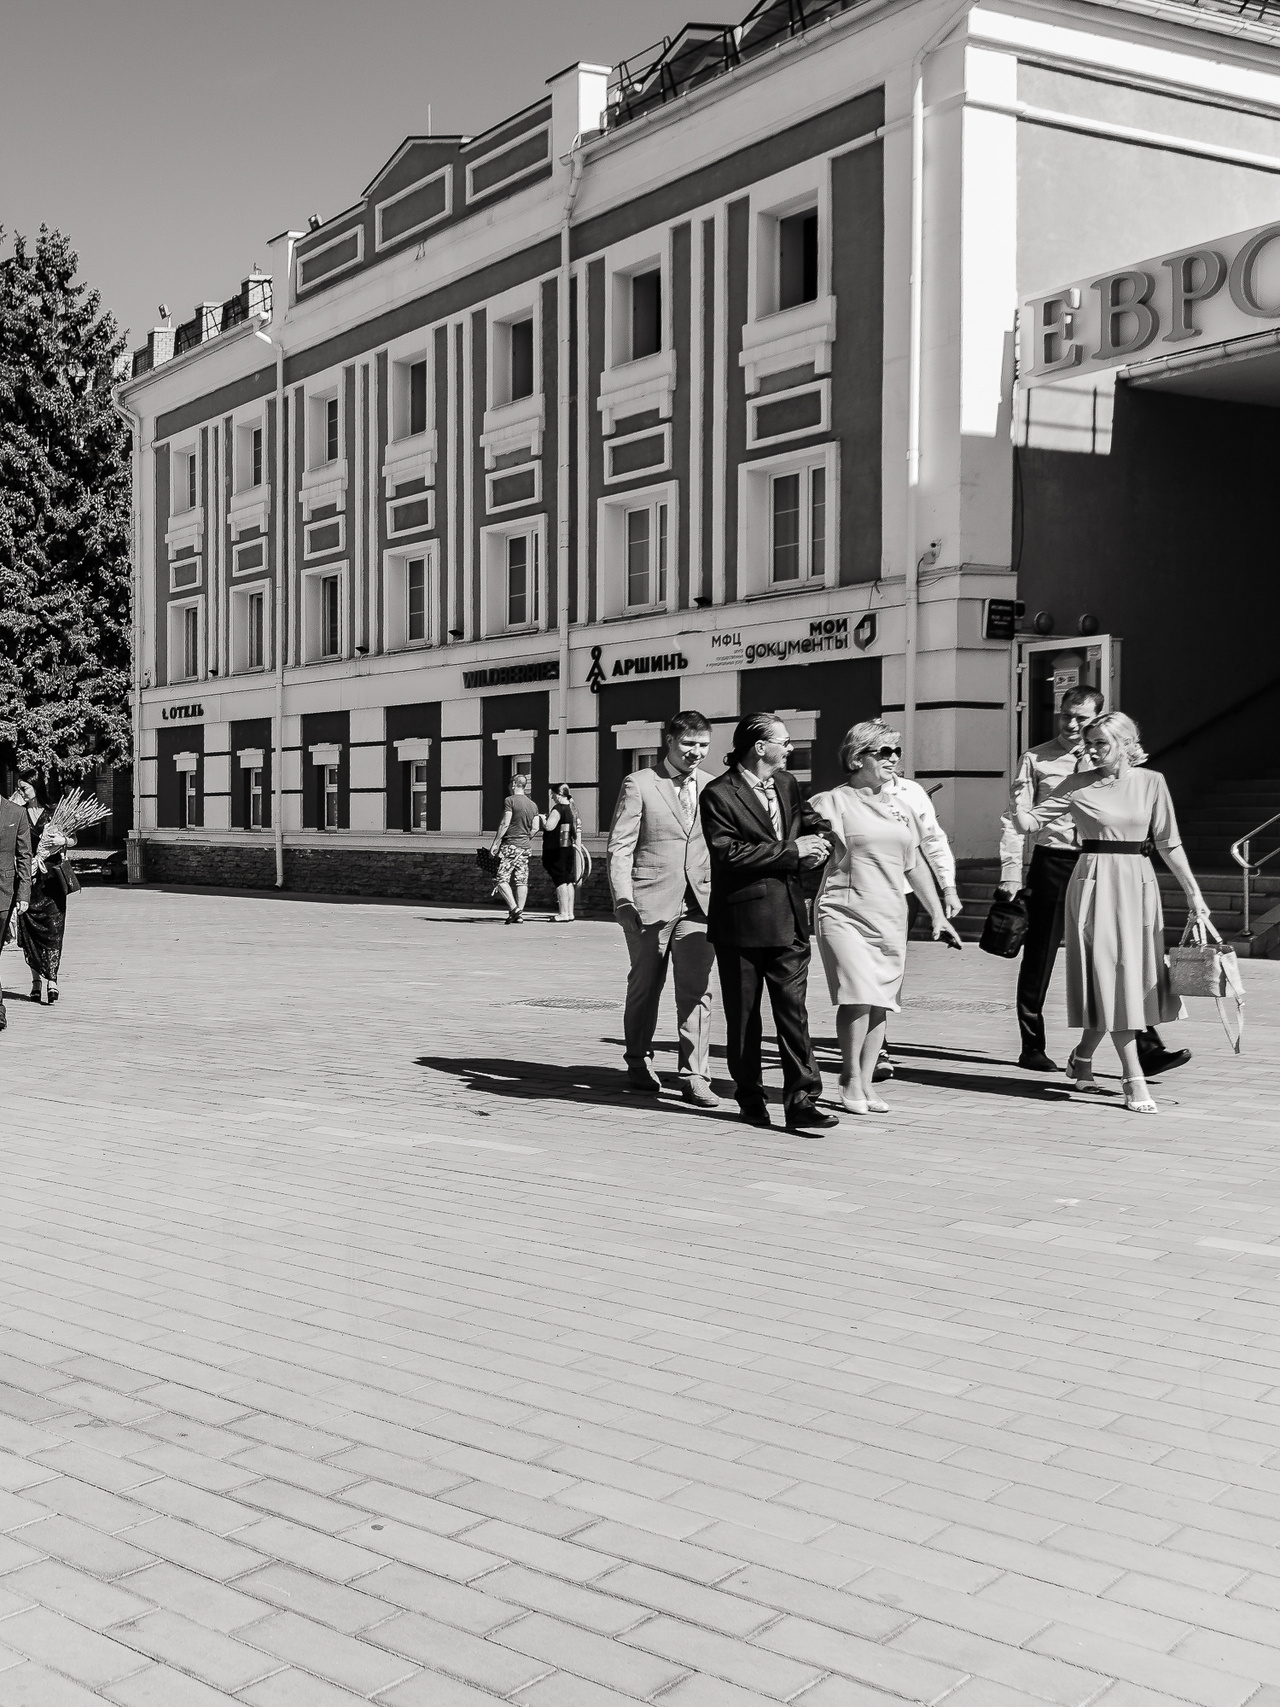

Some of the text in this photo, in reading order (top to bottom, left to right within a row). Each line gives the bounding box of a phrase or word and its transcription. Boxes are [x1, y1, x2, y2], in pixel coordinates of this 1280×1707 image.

[711, 632, 742, 648] МФЦ
[462, 660, 560, 689] WILDBERRIES
[612, 652, 689, 677] АРШИНЪ
[169, 703, 205, 720] ОТЕЛЬ
